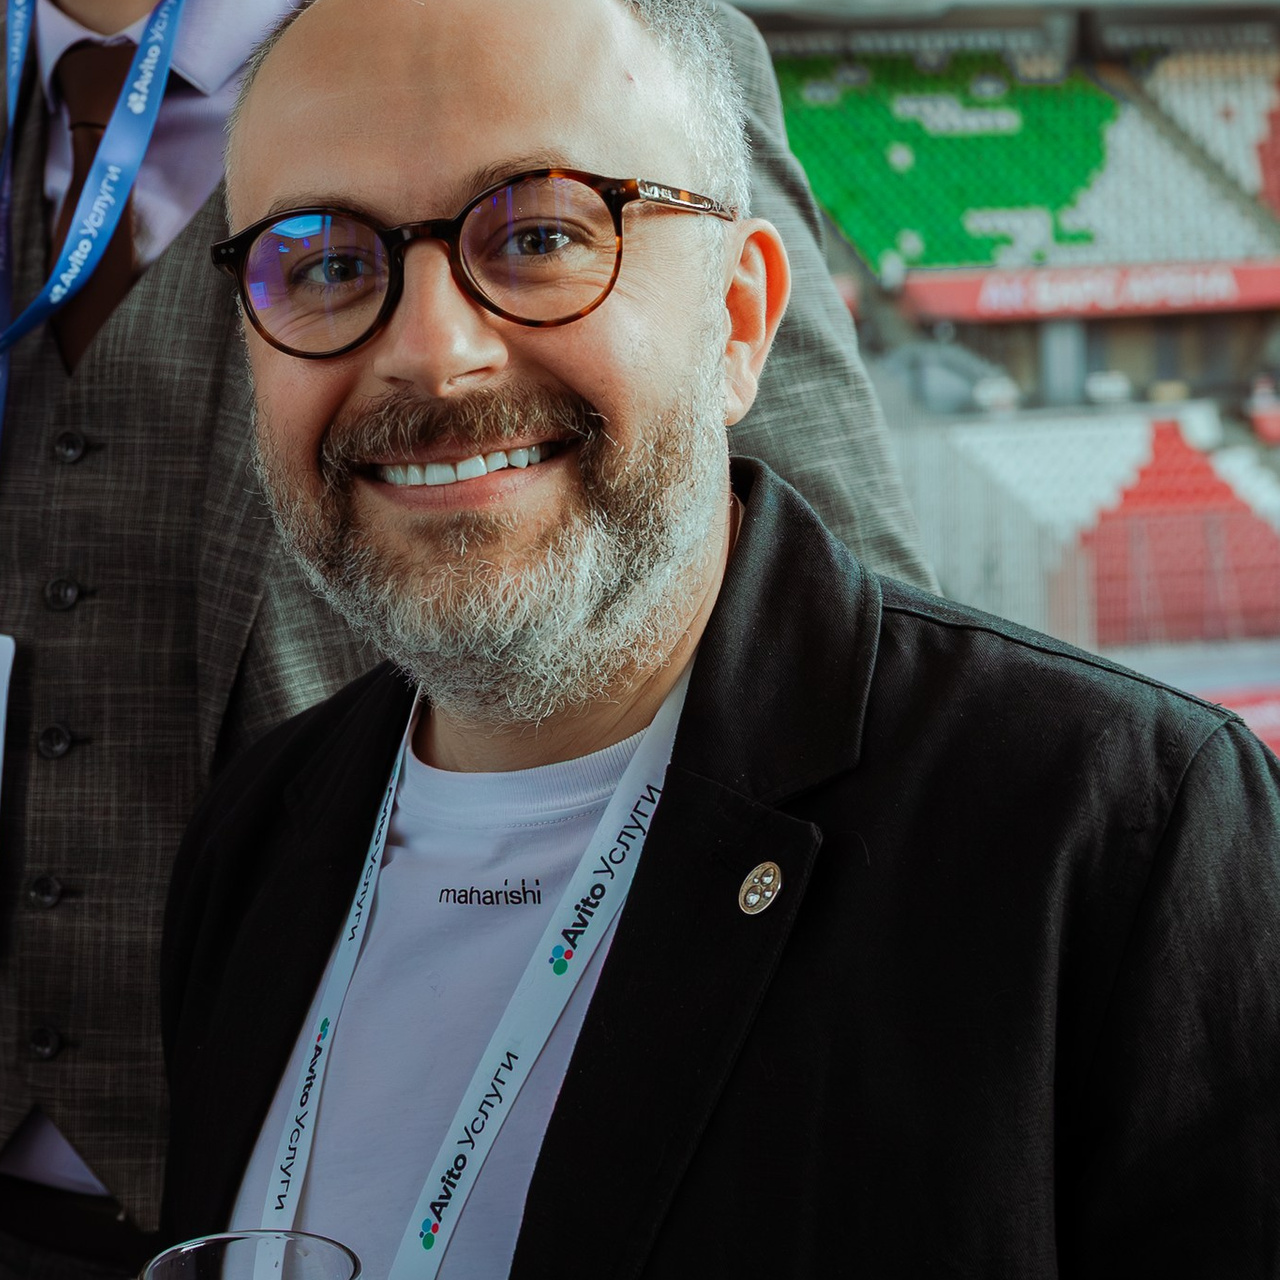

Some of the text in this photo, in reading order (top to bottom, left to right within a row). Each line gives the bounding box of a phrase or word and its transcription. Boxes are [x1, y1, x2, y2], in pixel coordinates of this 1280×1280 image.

[134, 44, 162, 97] Avito
[59, 165, 122, 289] Avito Услуги
[438, 878, 542, 906] maharishi
[561, 783, 663, 950] Avito Услуги
[274, 1043, 323, 1211] Avito Услуги
[429, 1050, 520, 1223] Avito Услуги
